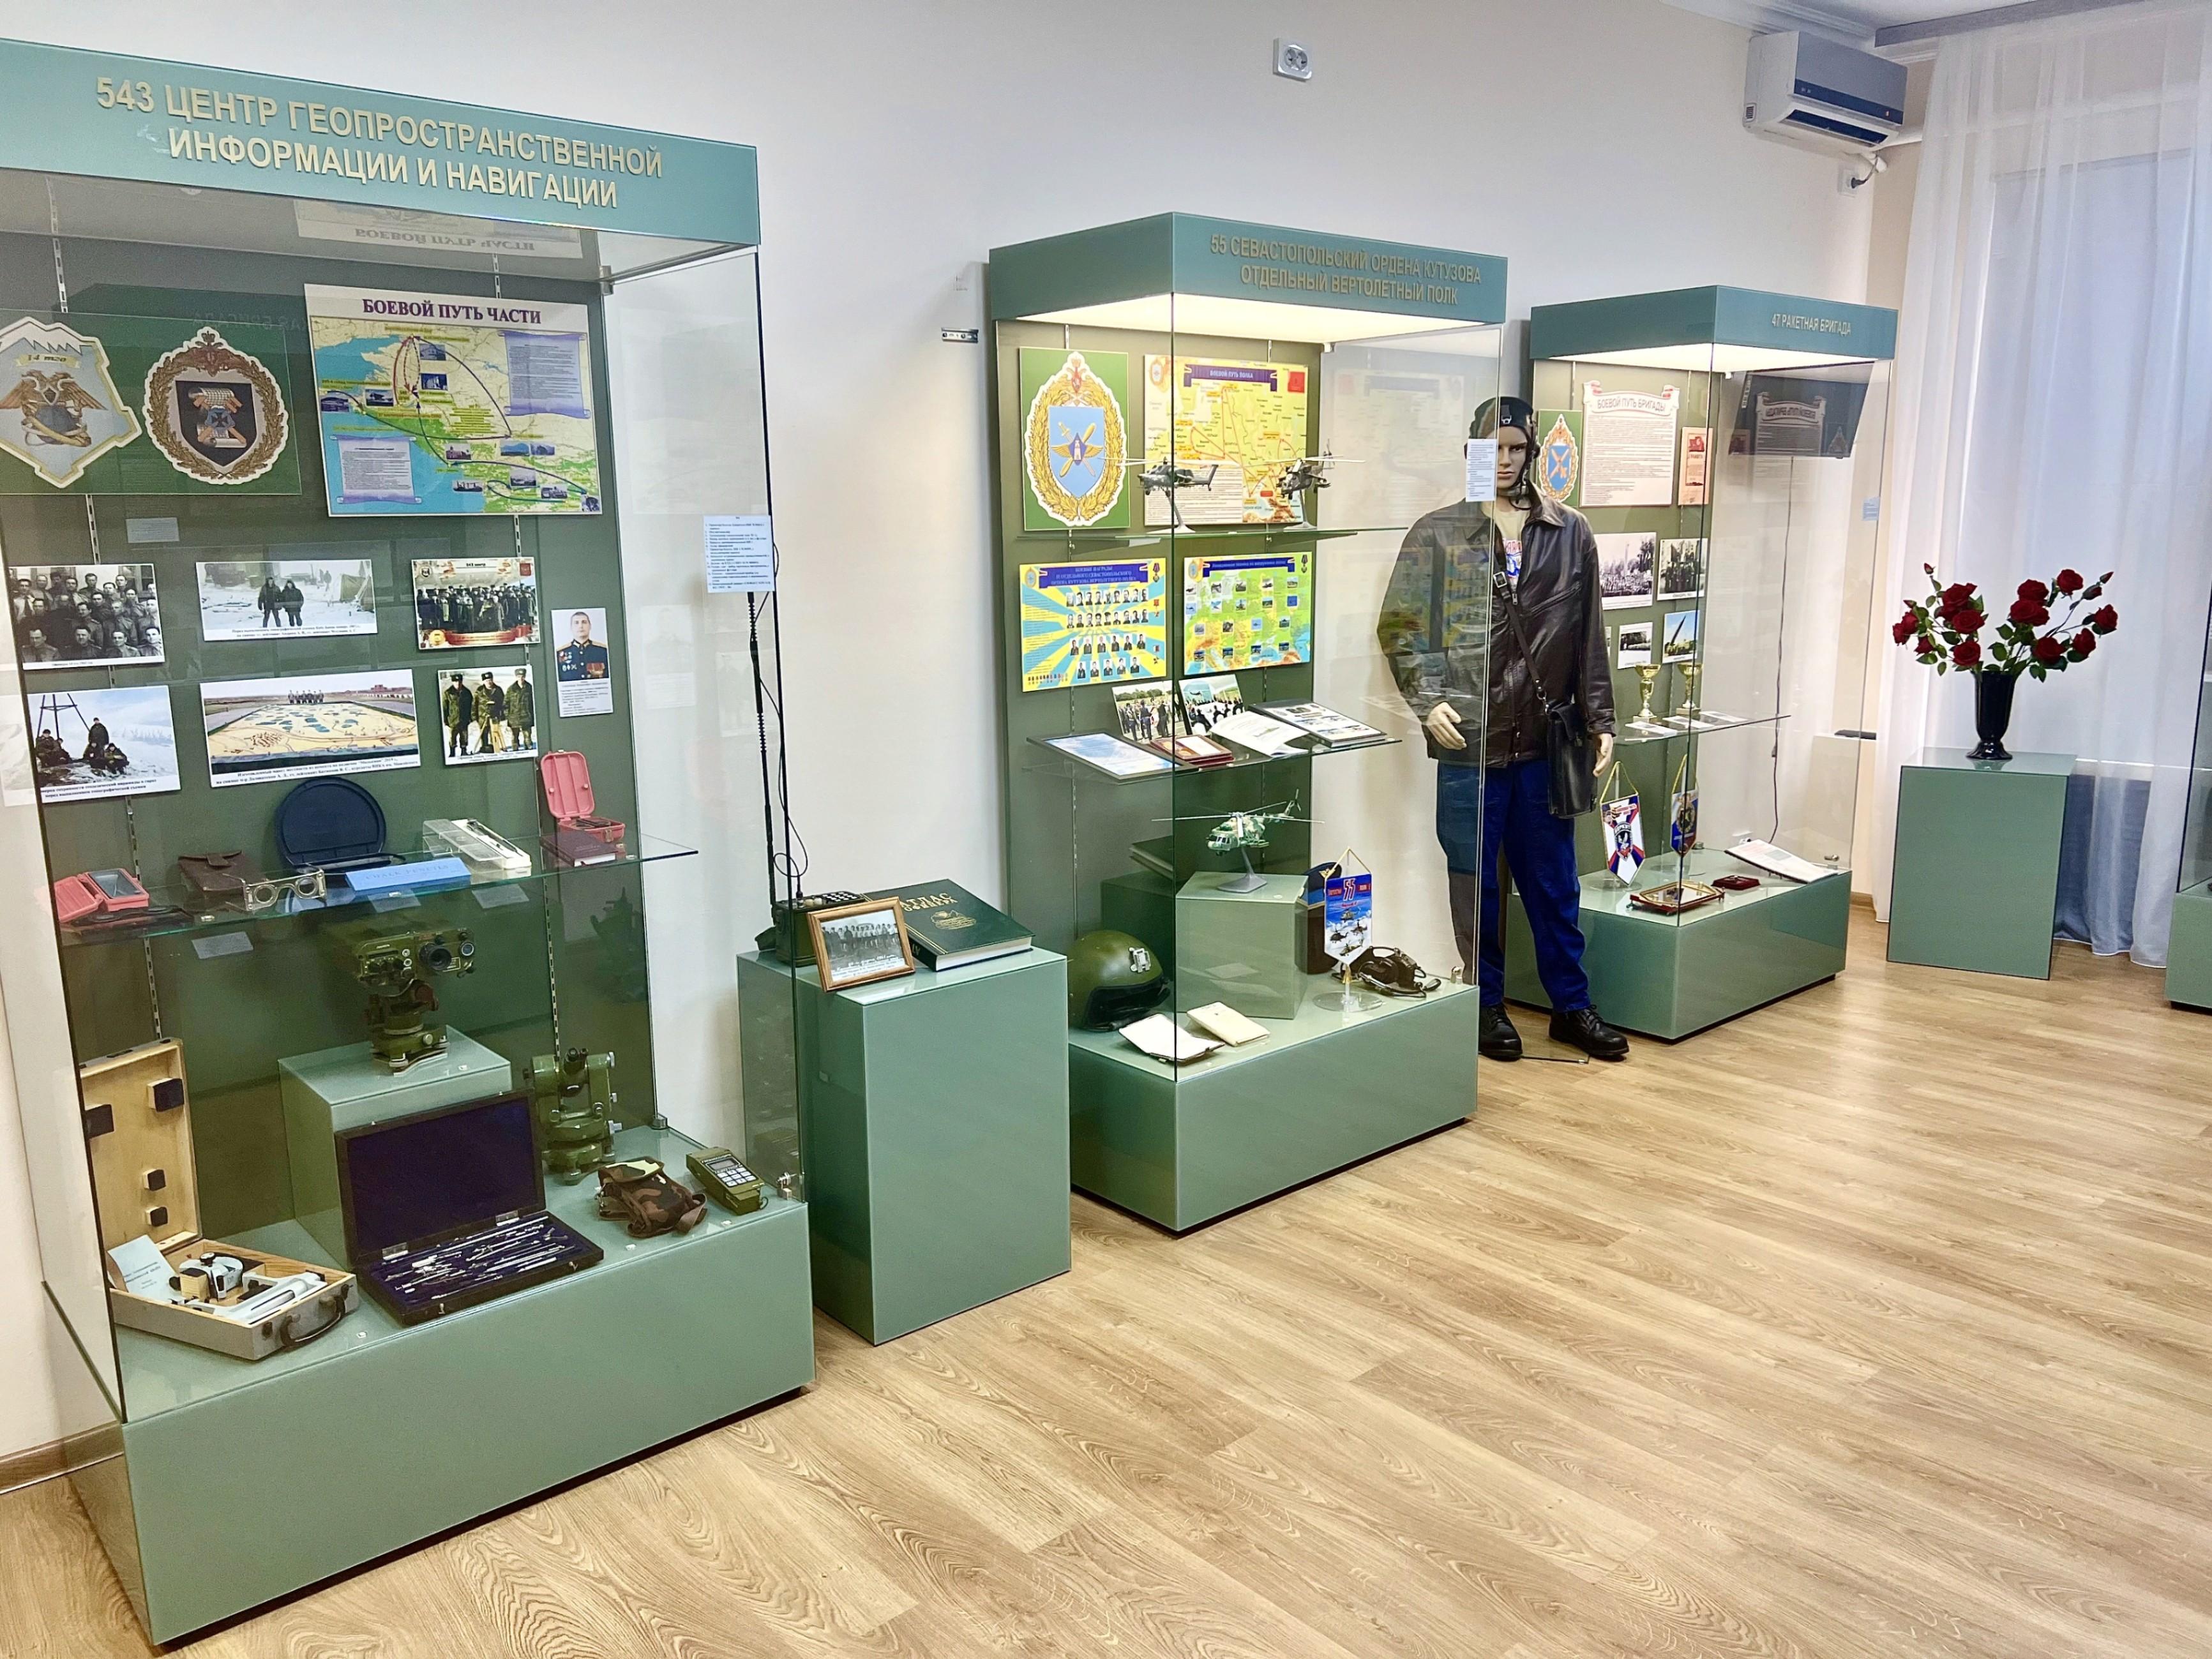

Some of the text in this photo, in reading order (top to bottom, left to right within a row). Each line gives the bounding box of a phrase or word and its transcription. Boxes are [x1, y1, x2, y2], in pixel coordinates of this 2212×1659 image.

[97, 76, 663, 178] 543 ЦЕНТР ГЕОПРОСТРАНСТВЕННОЙ
[168, 128, 618, 209] ИНФОРМАЦИИ И НАВИГАЦИИ
[1210, 234, 1482, 285] 55 СЕВАСТОПОЛЬСКИЙ ОРДЕНА КУТУЗОВА
[1240, 264, 1458, 306] ОТДЕЛЬНЫЙ ВЕРТОЛЕТНЫЙ ПОЛК
[361, 298, 542, 324] БОЕВОЙ ПУТЬ ЧАСТИ
[1772, 313, 1851, 337] 47 РАКЕТНАЯ БРИГАДА
[1597, 396, 1666, 412] БОЕВОЙ ПУТЬ БРИГАДЫ
[1343, 878, 1356, 901] 55
